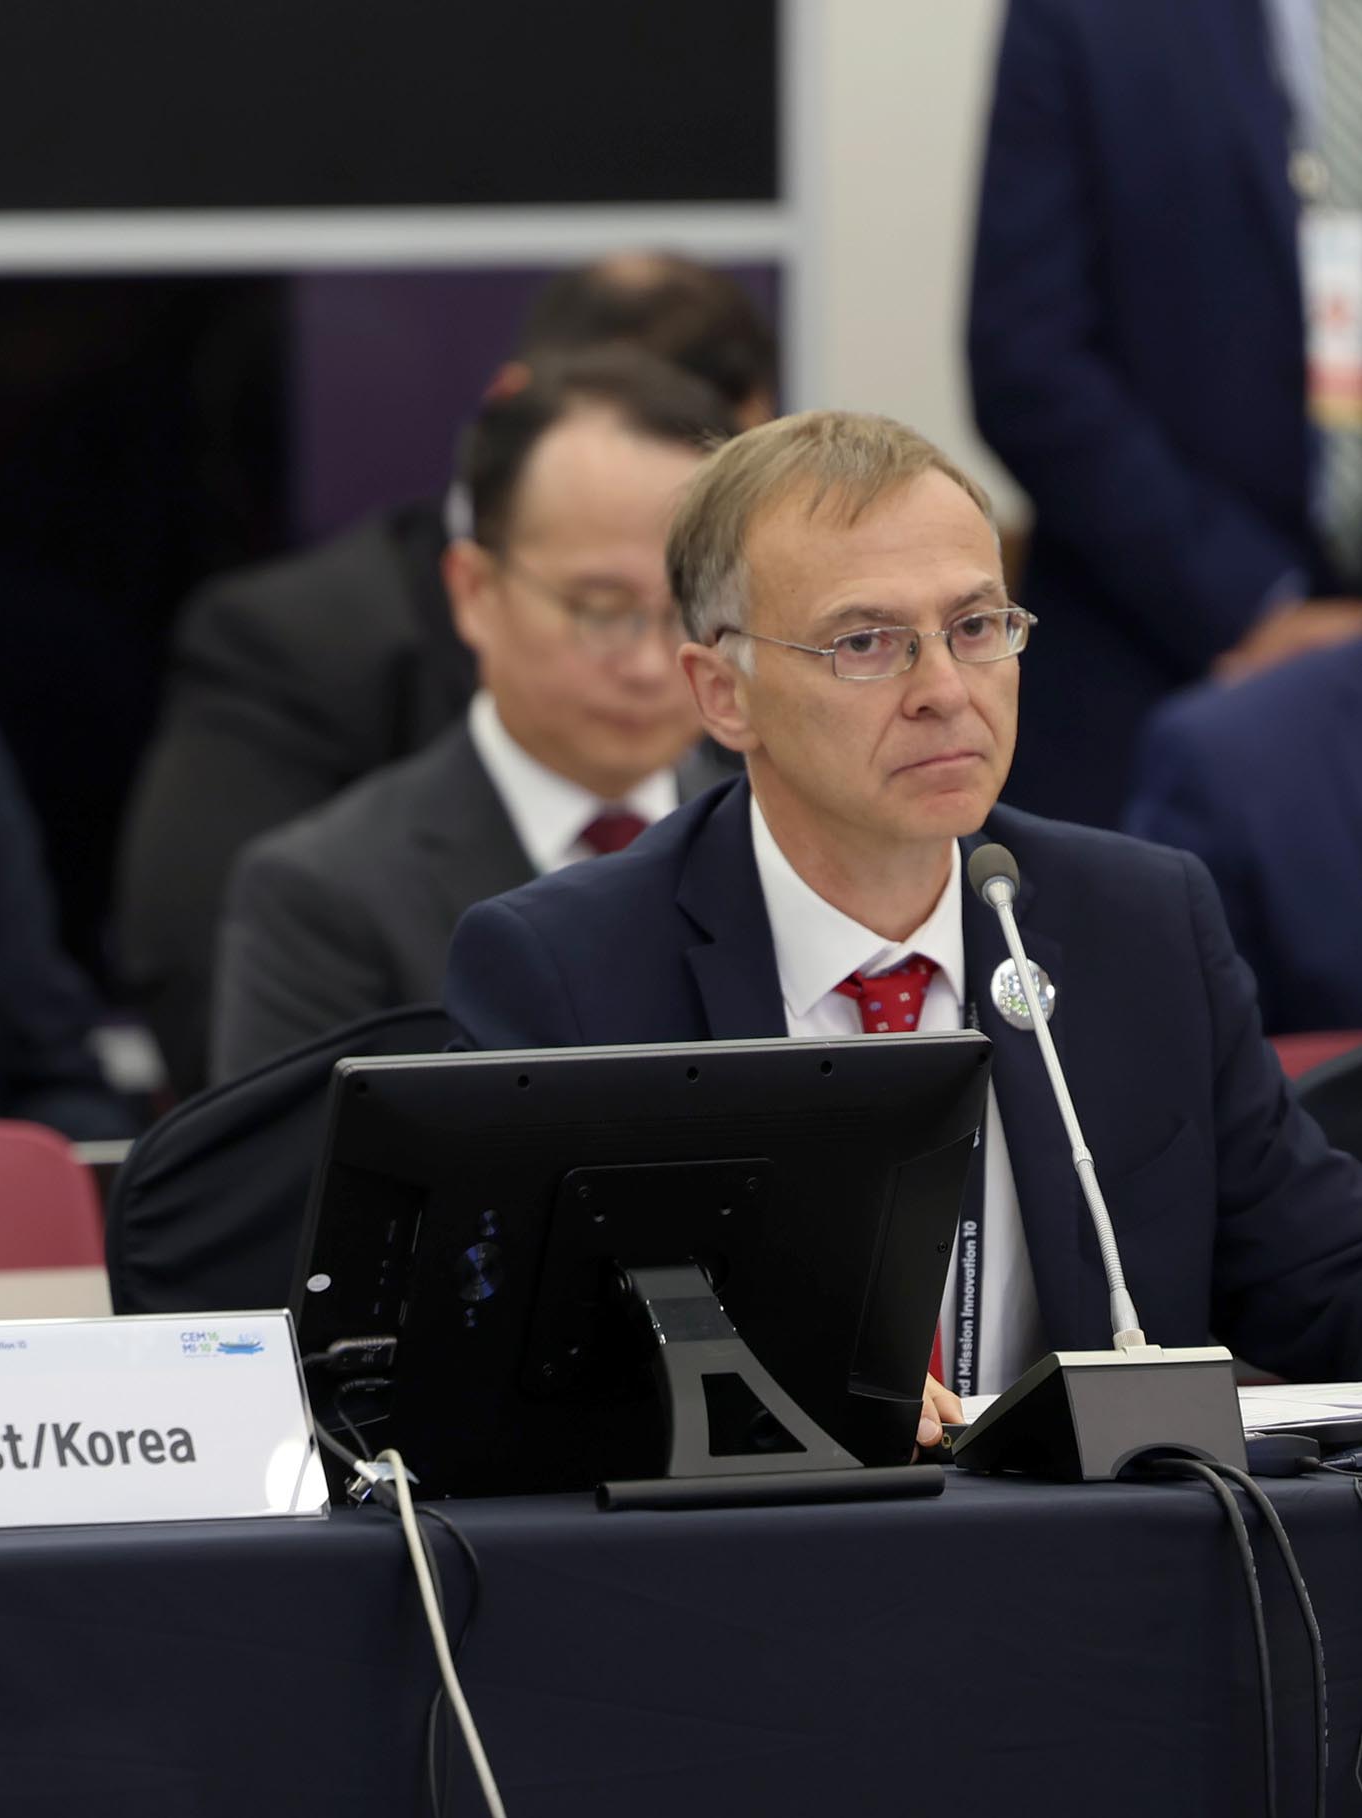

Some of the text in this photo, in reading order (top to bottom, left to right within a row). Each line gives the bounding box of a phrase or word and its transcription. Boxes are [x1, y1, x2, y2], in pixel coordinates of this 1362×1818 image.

[963, 1220, 978, 1237] 10
[961, 1239, 977, 1317] Innovation
[959, 1319, 975, 1377] Mission
